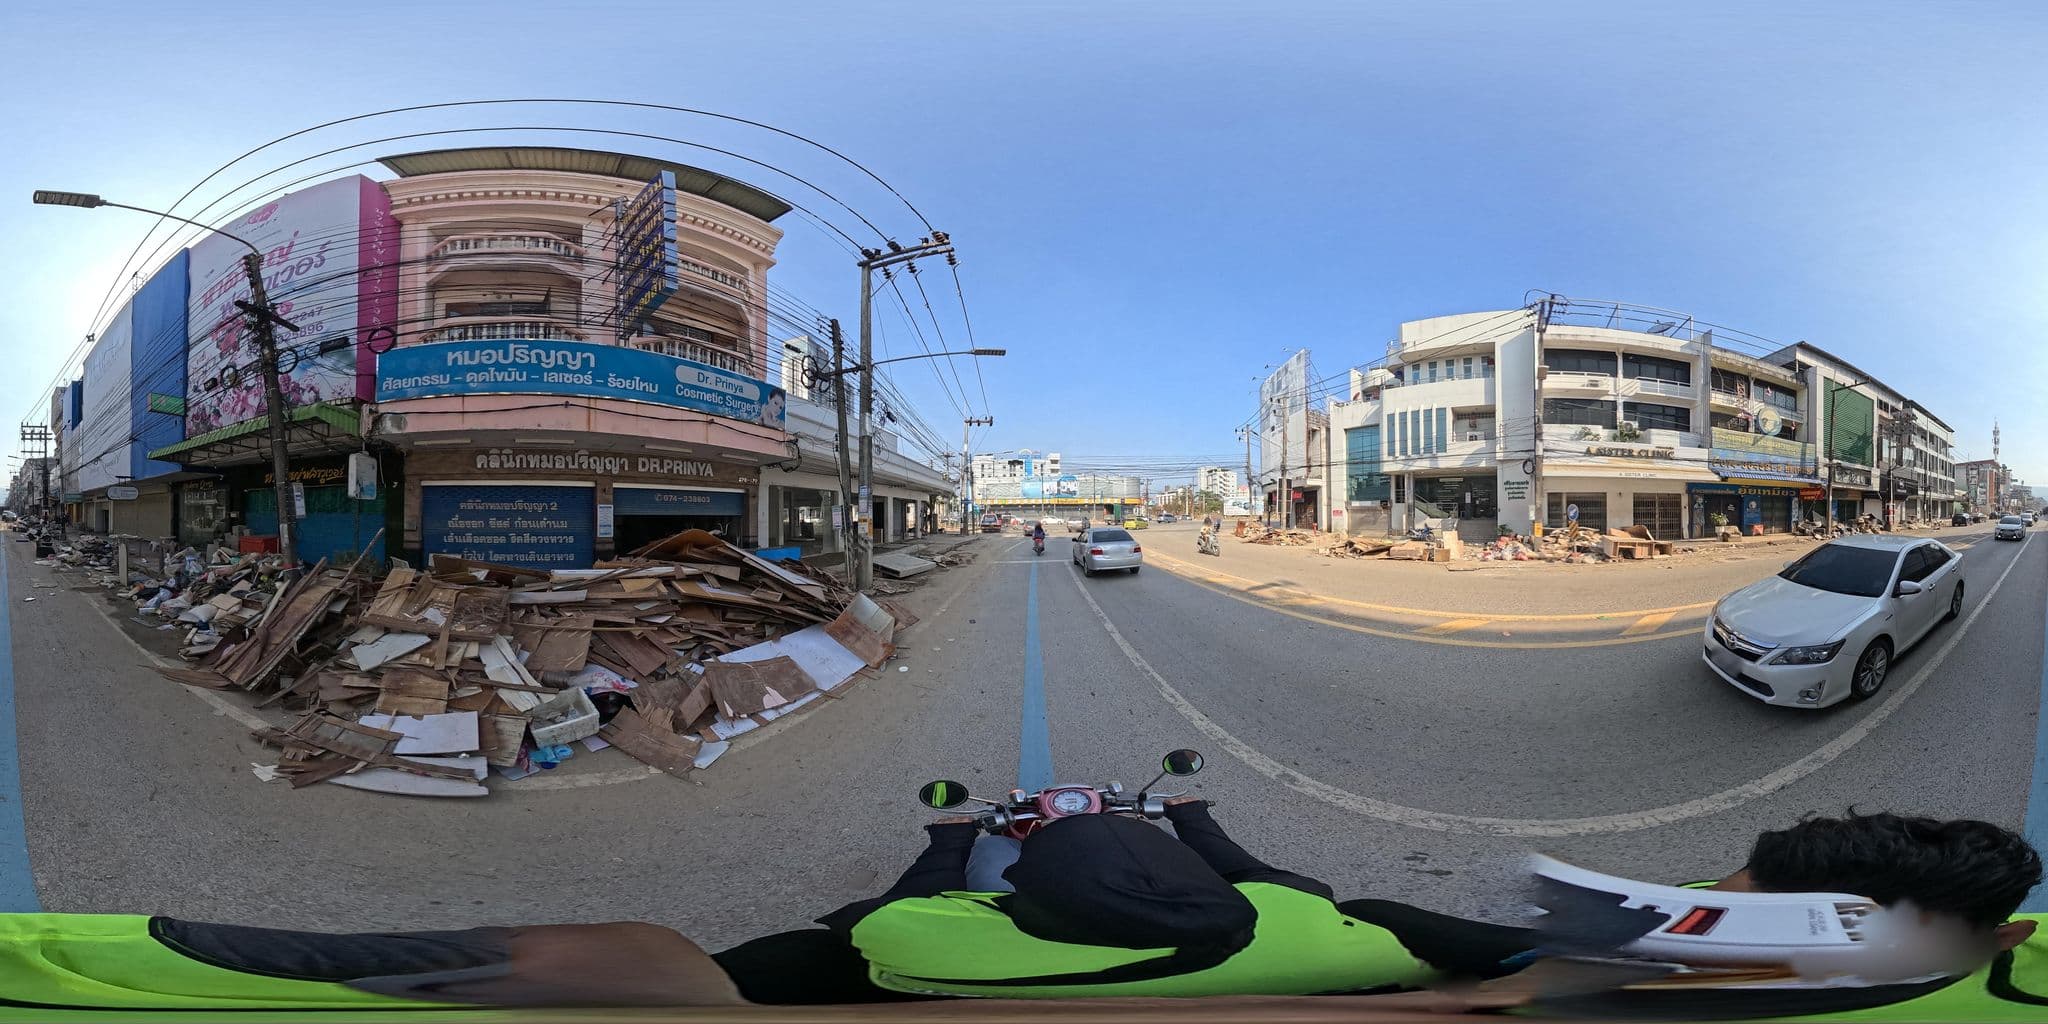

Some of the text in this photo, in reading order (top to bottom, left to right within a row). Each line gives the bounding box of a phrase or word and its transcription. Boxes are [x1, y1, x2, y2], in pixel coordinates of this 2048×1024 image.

[447, 343, 596, 369] หมอปริญญา
[382, 373, 450, 391] ศัลยกรรม
[465, 367, 527, 387] ดูดไขมัน
[543, 370, 593, 385] เลเซอร์
[607, 372, 659, 394] ร้อยไหม
[697, 371, 744, 394] Dr. Prinya
[675, 383, 760, 415] Cosmetic Surgery
[476, 449, 715, 478] คลินิกหมอปริญญา DR.PRINYA
[550, 502, 558, 511] 2
